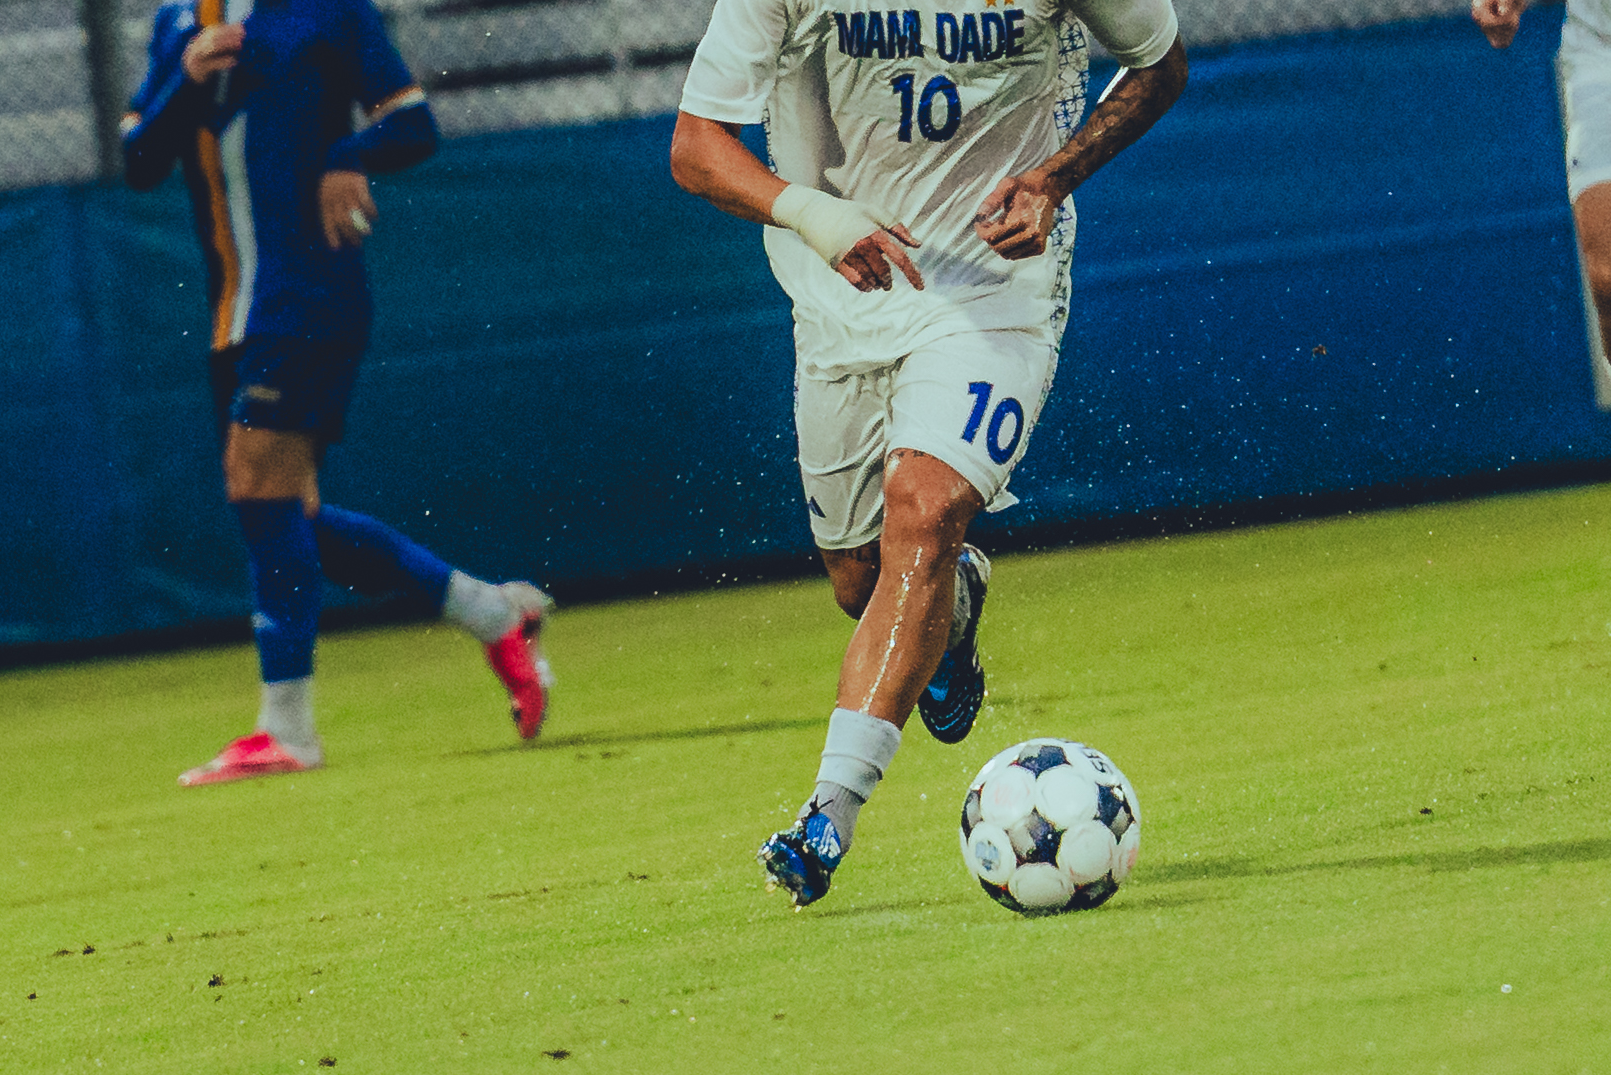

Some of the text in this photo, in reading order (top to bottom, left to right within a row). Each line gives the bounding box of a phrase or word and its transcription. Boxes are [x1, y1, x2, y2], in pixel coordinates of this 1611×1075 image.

[935, 9, 1025, 64] DADE
[890, 73, 963, 143] 10
[960, 380, 1025, 466] 10
